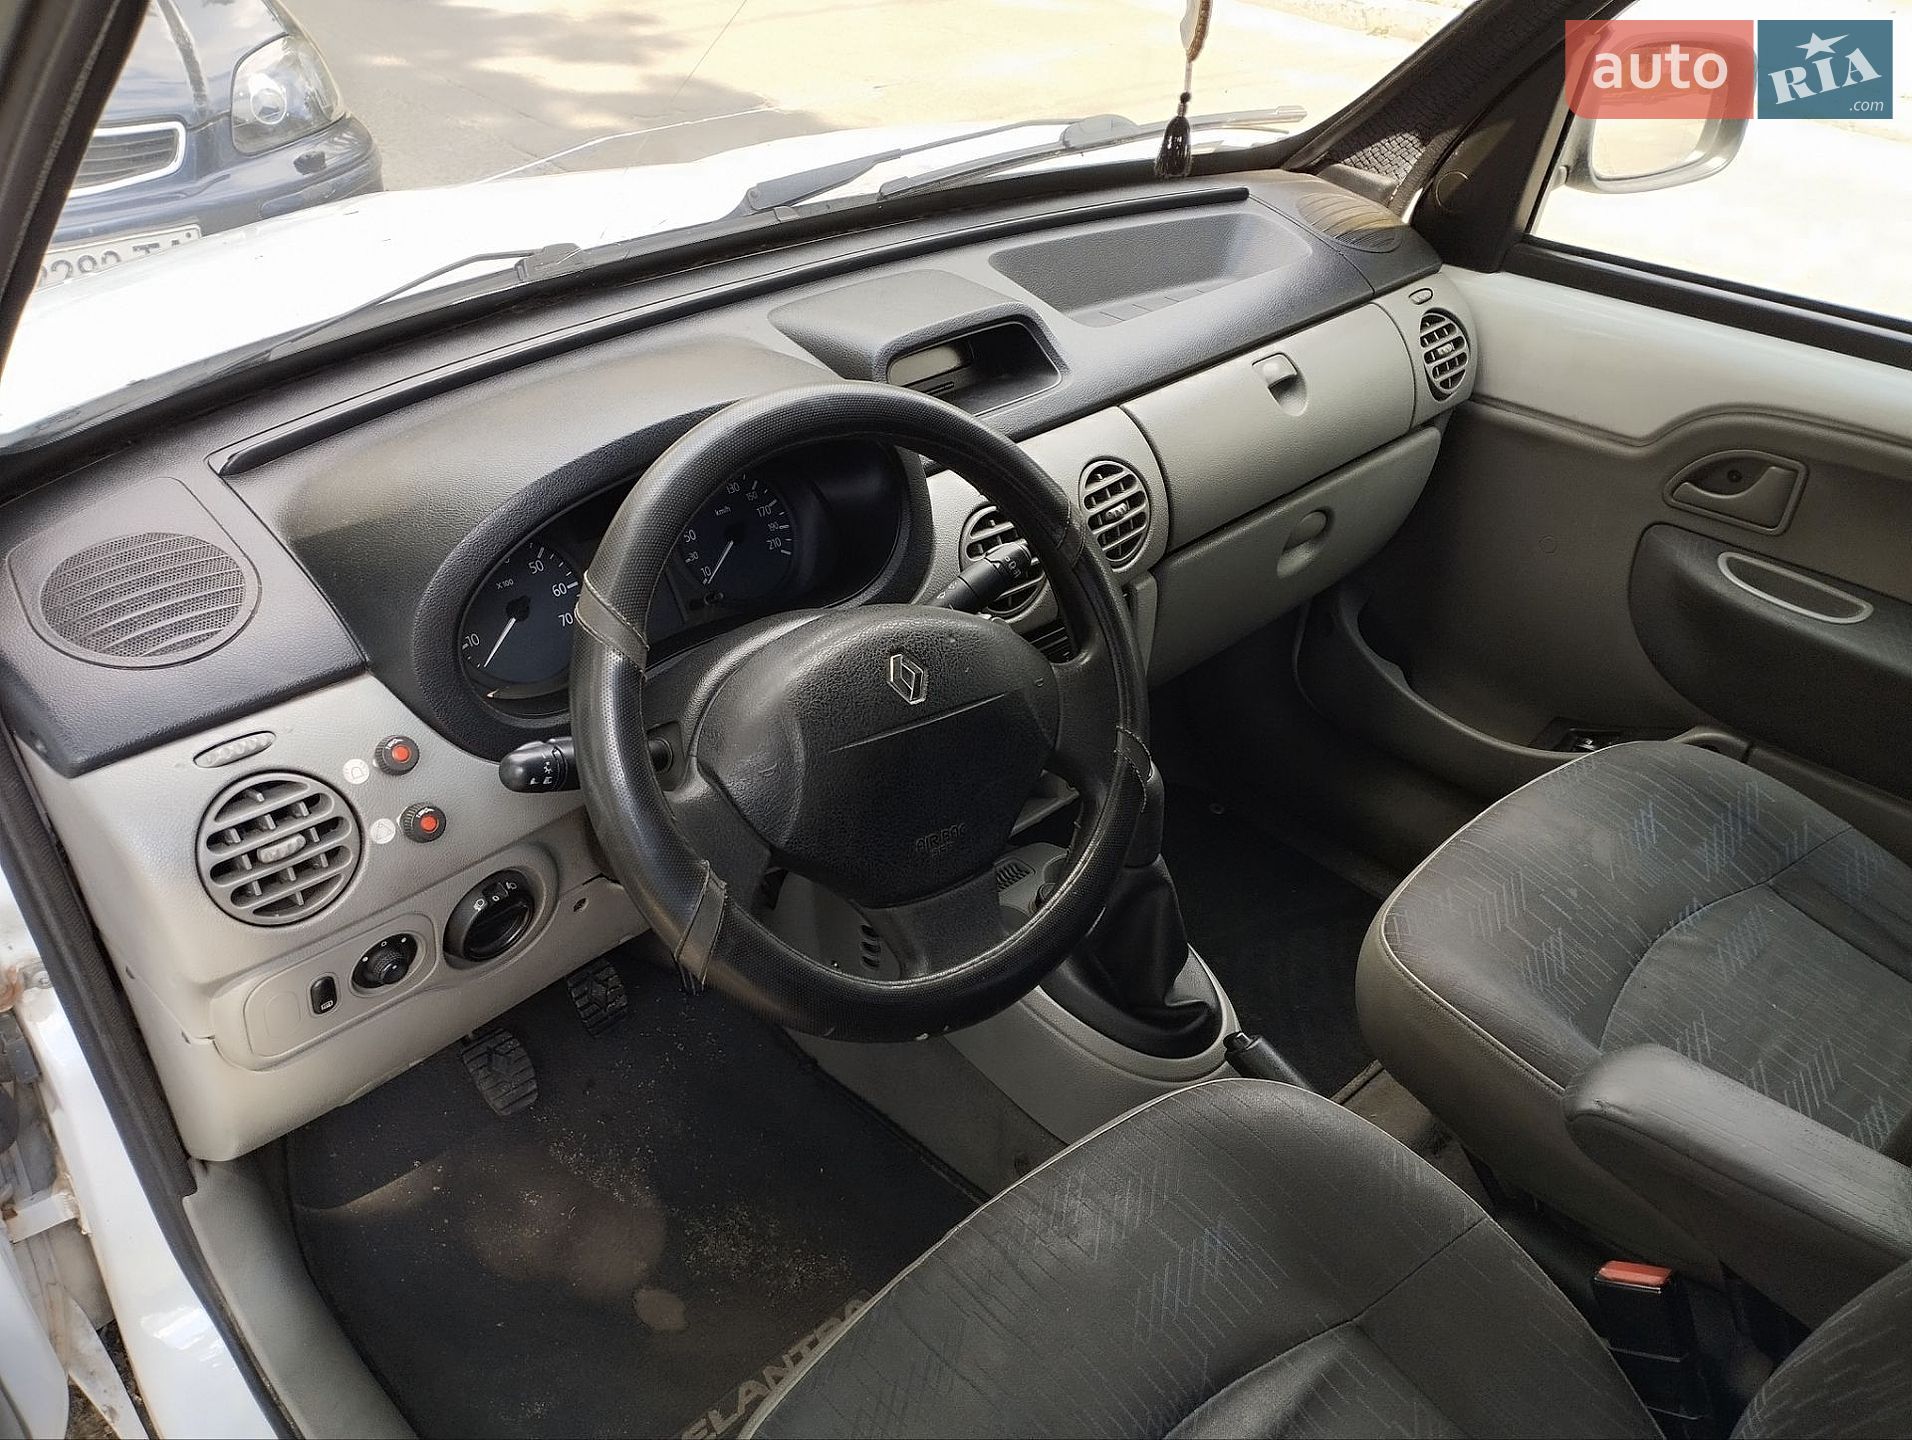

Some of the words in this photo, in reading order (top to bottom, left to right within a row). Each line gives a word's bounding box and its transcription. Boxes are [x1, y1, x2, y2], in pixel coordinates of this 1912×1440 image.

[757, 505, 772, 517] 170
[683, 529, 697, 543] 50
[527, 559, 544, 576] 50
[551, 582, 568, 598] 60
[557, 612, 574, 628] 70
